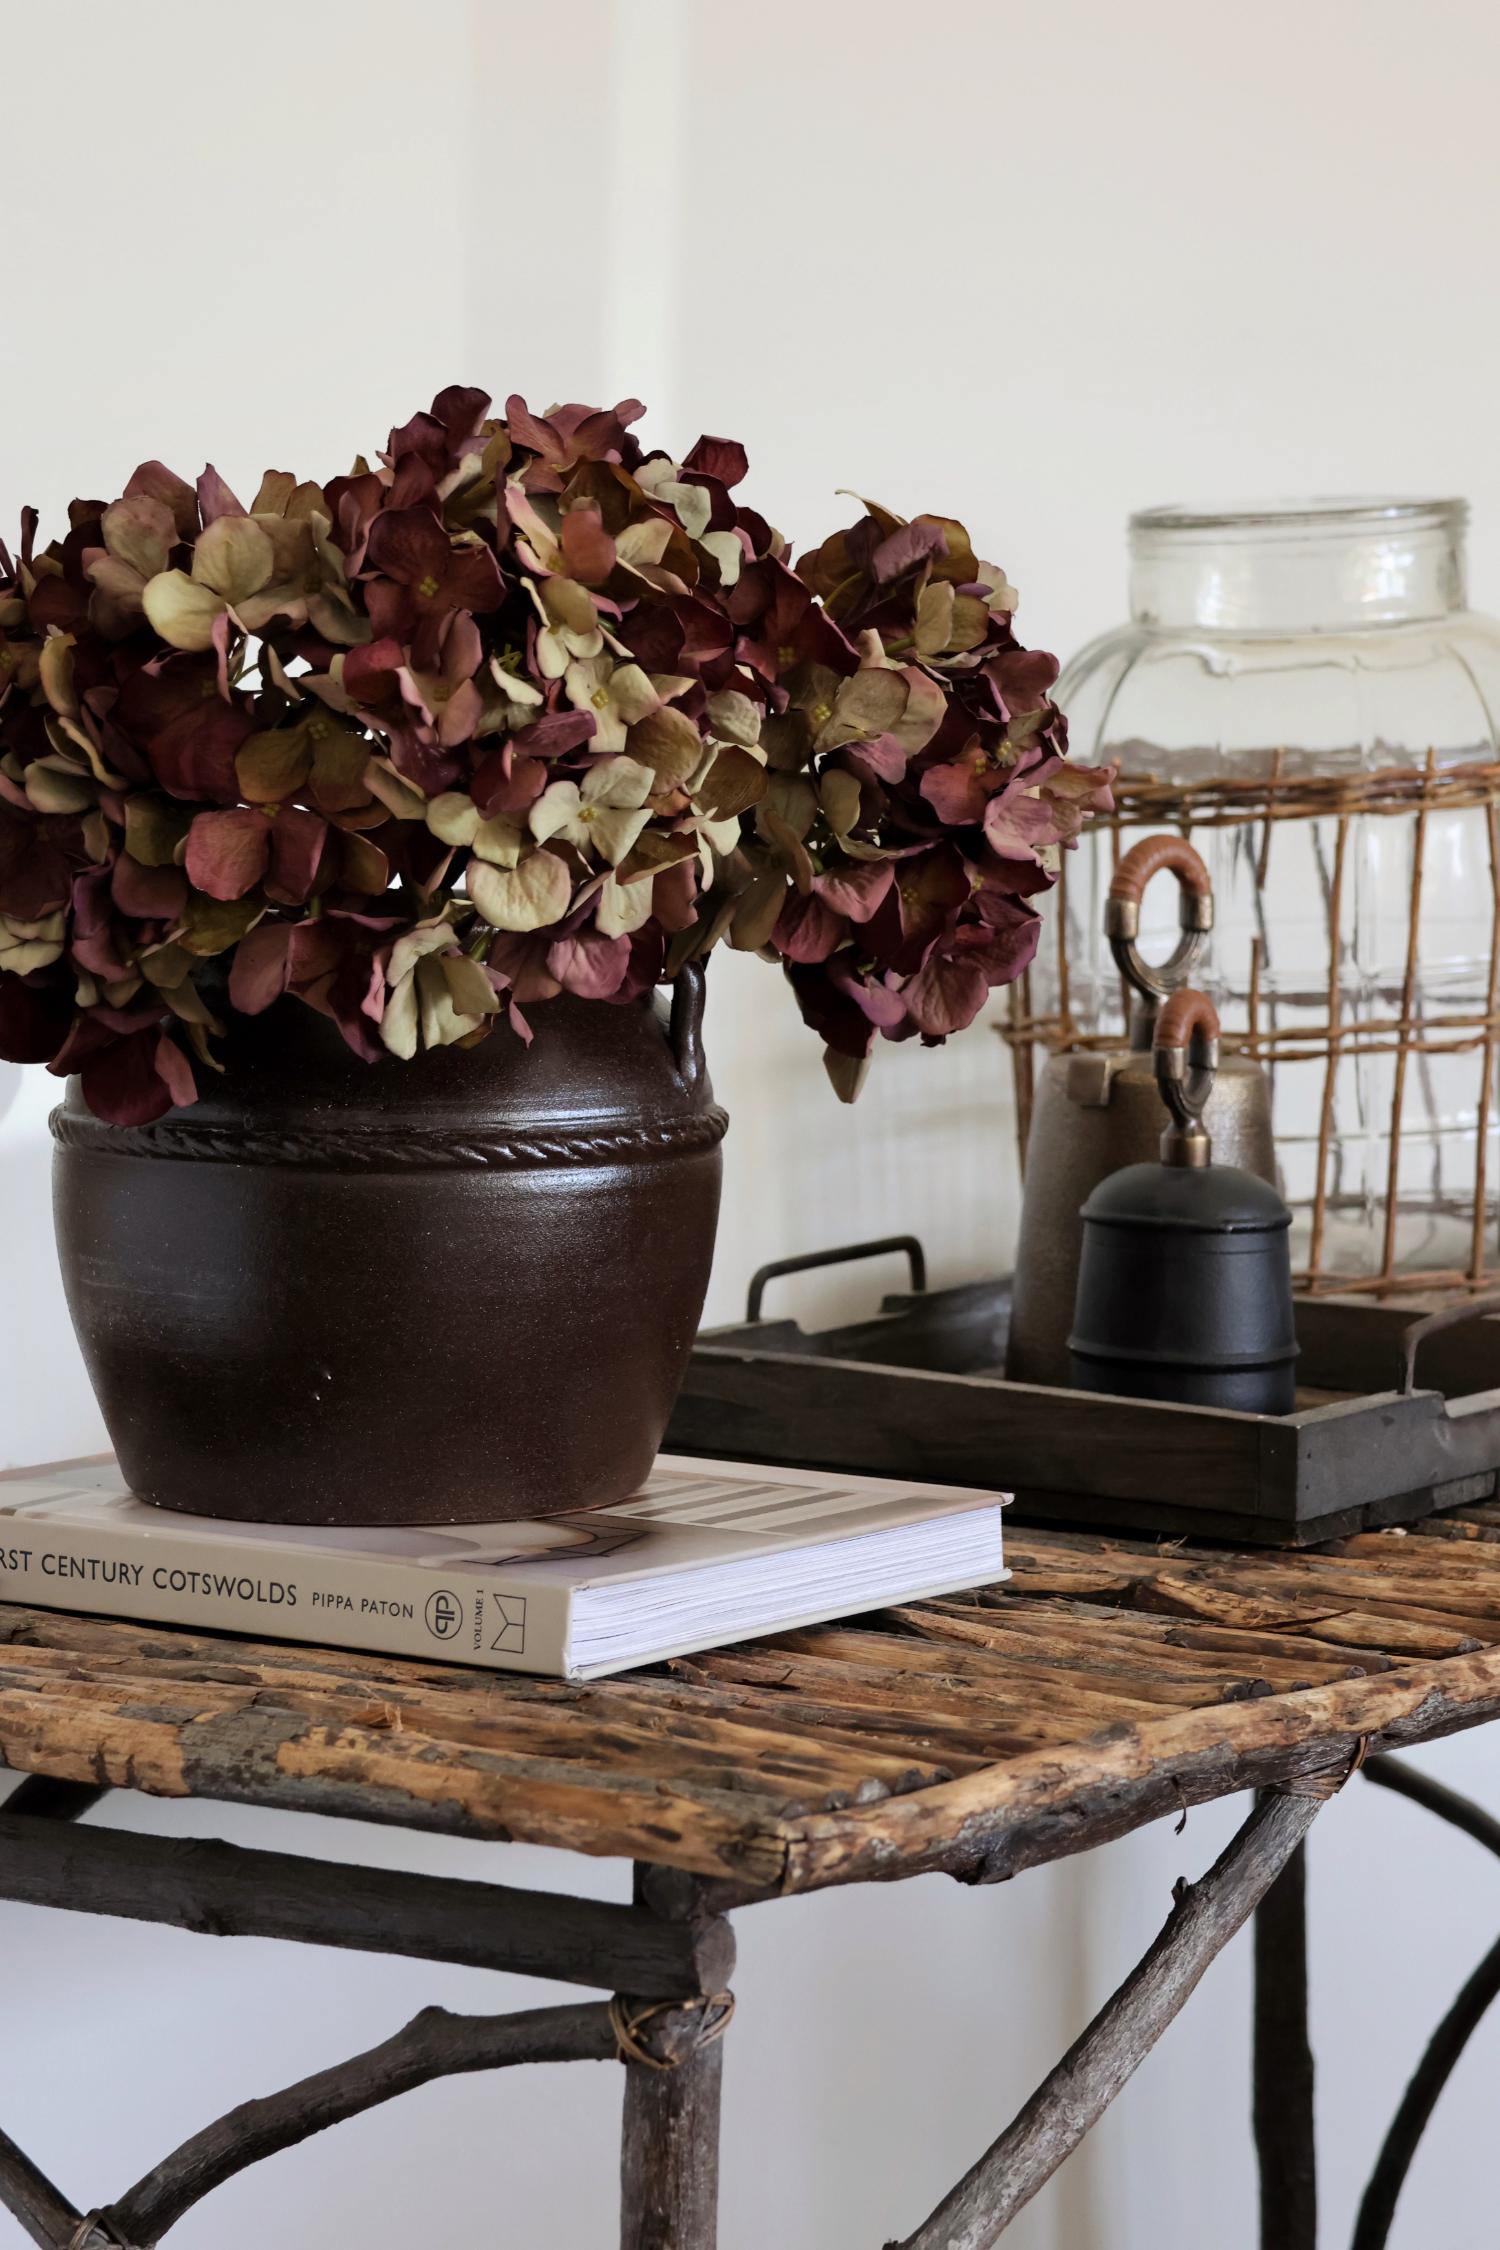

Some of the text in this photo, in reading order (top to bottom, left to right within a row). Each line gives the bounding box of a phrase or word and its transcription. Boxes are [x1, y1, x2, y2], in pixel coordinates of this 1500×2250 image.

[41, 1553, 144, 1585] CENTURY
[153, 1567, 297, 1606] COTSWOLDS
[312, 1591, 353, 1611] PIPPA
[361, 1598, 413, 1618] PATON
[473, 1598, 484, 1650] VOLUME
